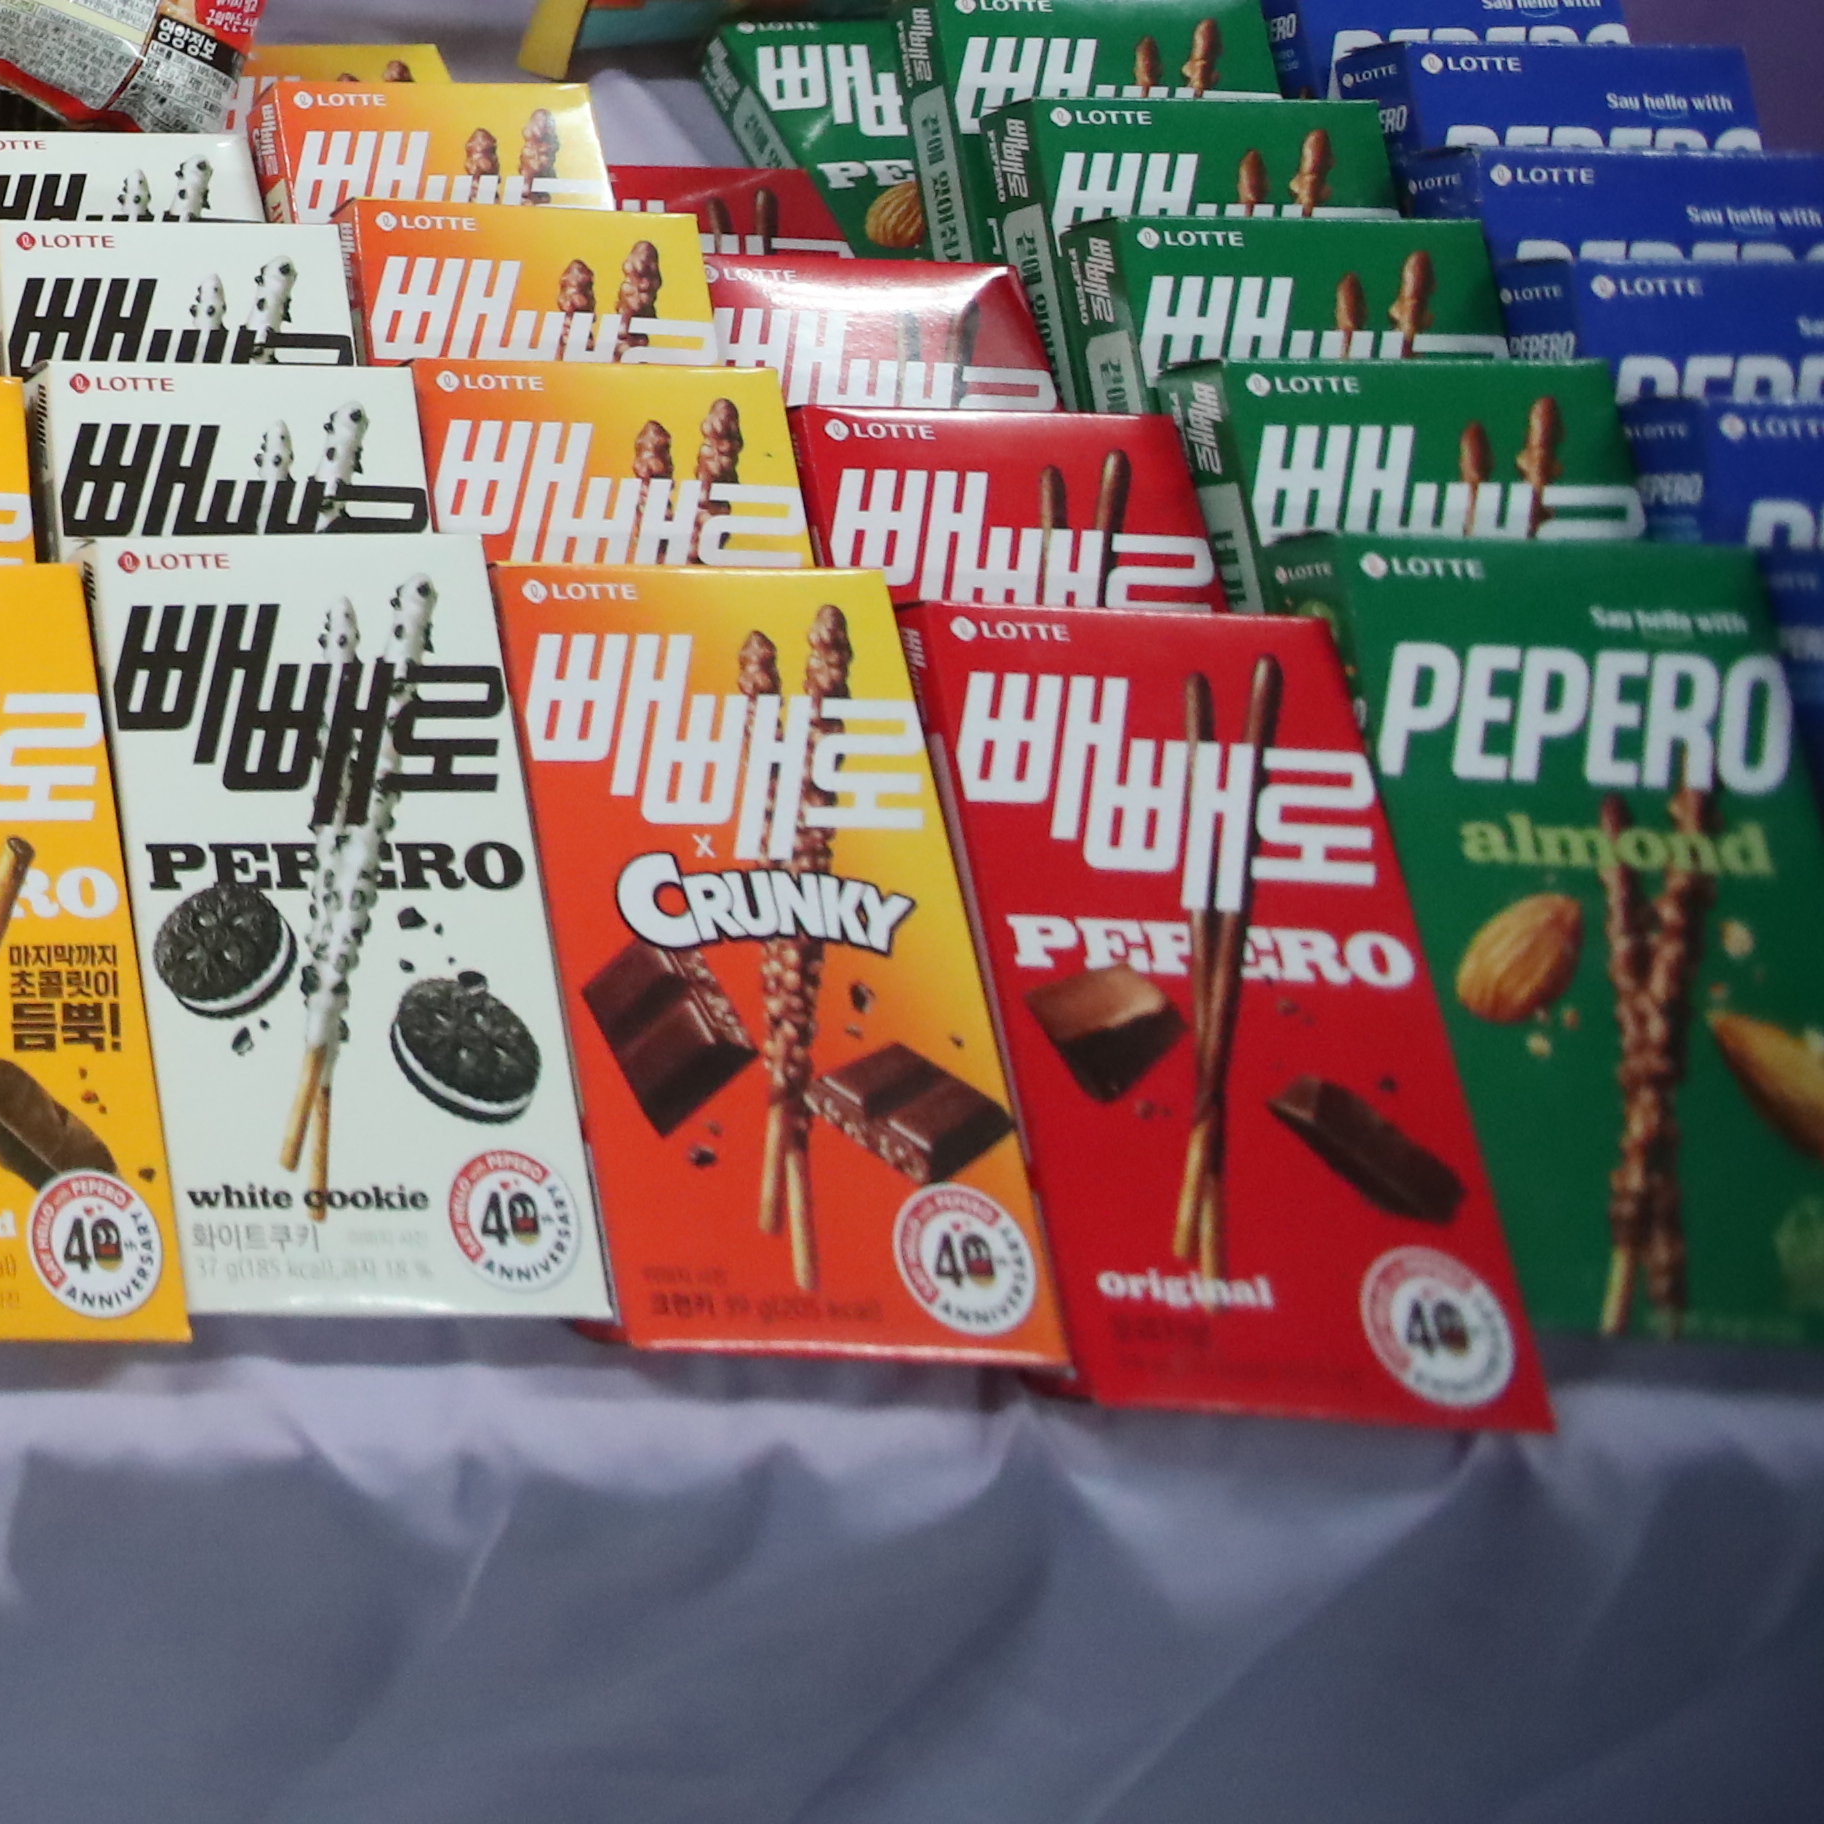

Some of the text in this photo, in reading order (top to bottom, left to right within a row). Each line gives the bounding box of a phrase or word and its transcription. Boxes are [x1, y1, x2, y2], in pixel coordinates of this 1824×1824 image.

[157, 18, 219, 60] 영양정보
[1446, 56, 1522, 72] LOTTE
[316, 93, 387, 108] LOTTE
[1606, 93, 1733, 112] Say hello with
[1075, 110, 1153, 126] LOTTE
[1515, 167, 1595, 185] LOTTE
[401, 216, 477, 232] LOTTE
[40, 234, 115, 250] LOTTE
[1163, 230, 1245, 247] LOTTE
[1619, 277, 1704, 297] LOTTE
[95, 375, 175, 393] LOTTE
[464, 374, 545, 392] LOTTE
[1274, 375, 1360, 395] LOTTE
[852, 422, 936, 441] LOTTE
[146, 551, 231, 570] LOTTE
[1391, 556, 1484, 582] LOTTE
[552, 582, 639, 600] LOTTE
[981, 622, 1071, 643] LOTTE
[112, 603, 506, 827] 빼빼로
[1378, 641, 1791, 795] PEPERO
[525, 633, 925, 861] 빼빼로
[956, 670, 1378, 914] 빼빼로
[1460, 813, 1775, 876] almond
[616, 852, 916, 956] CRUNKY
[8, 944, 118, 968] 마지막까지
[10, 970, 120, 999] 초콜릿이
[12, 1002, 123, 1053] 듬뿍!
[188, 1182, 430, 1213] white cookie
[192, 1223, 321, 1253] 화이트쿠키
[1097, 1269, 1274, 1310] original
